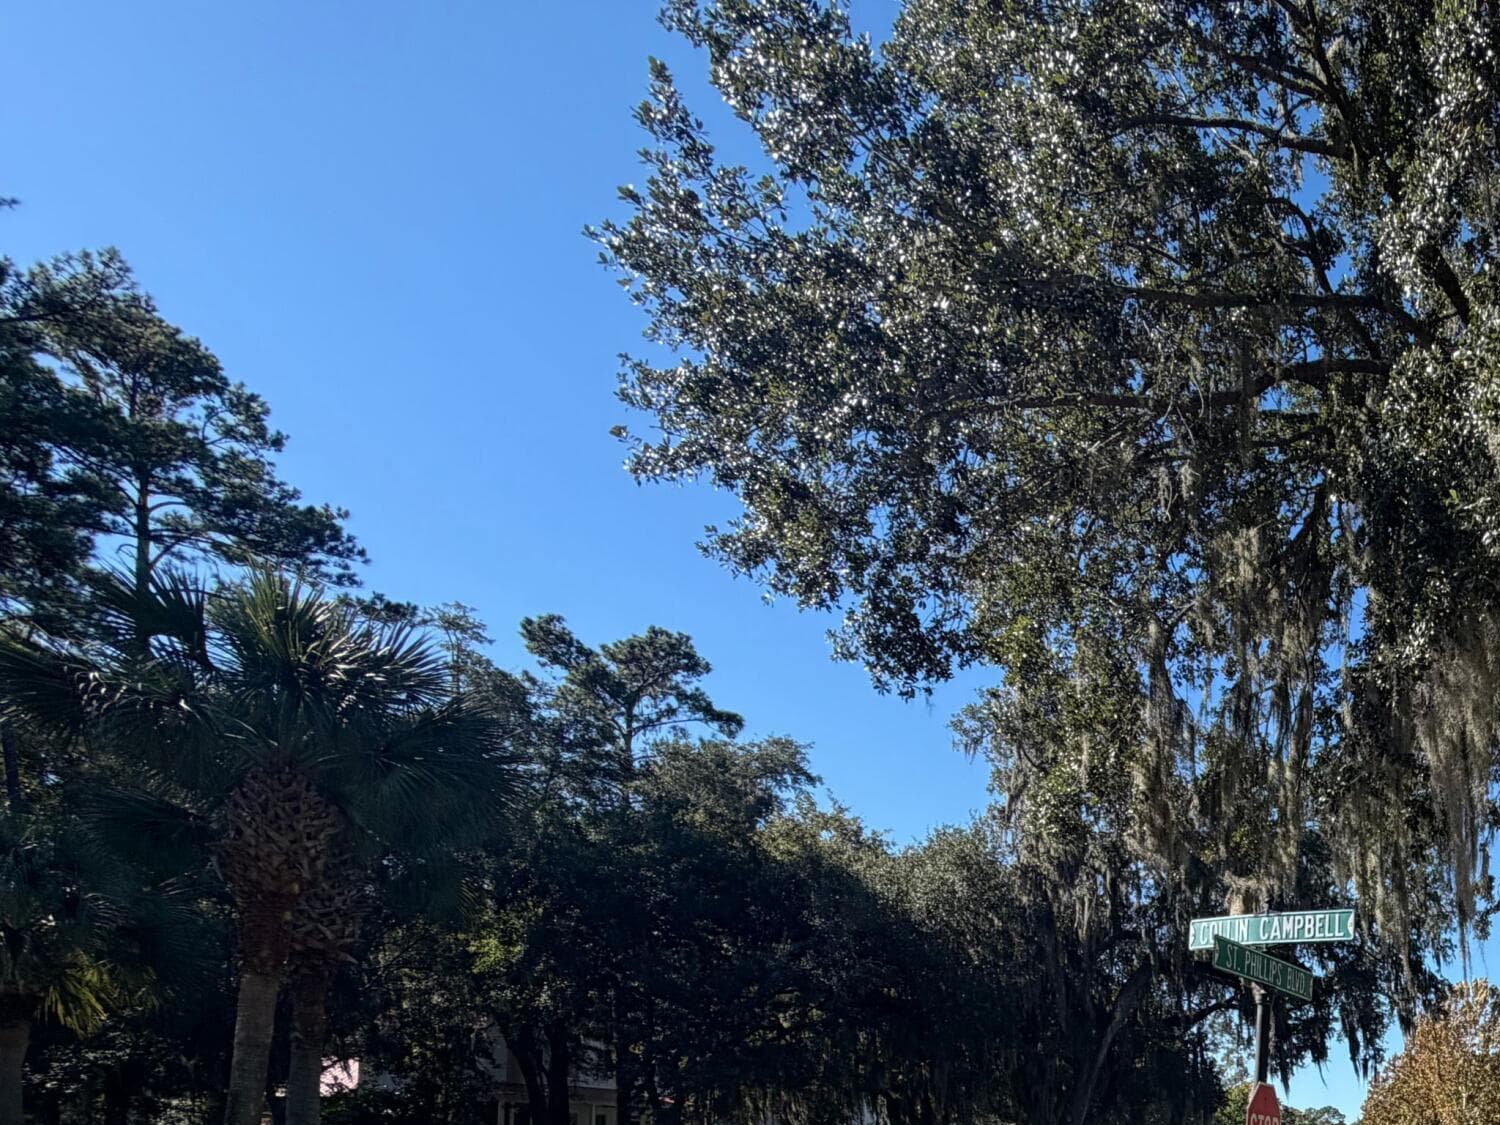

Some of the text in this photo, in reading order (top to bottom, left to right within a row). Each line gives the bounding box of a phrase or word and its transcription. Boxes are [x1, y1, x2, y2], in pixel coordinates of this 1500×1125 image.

[1259, 914, 1344, 941] CAMPBELL
[1226, 943, 1307, 996] ST. PHILLIPS BLVD.
